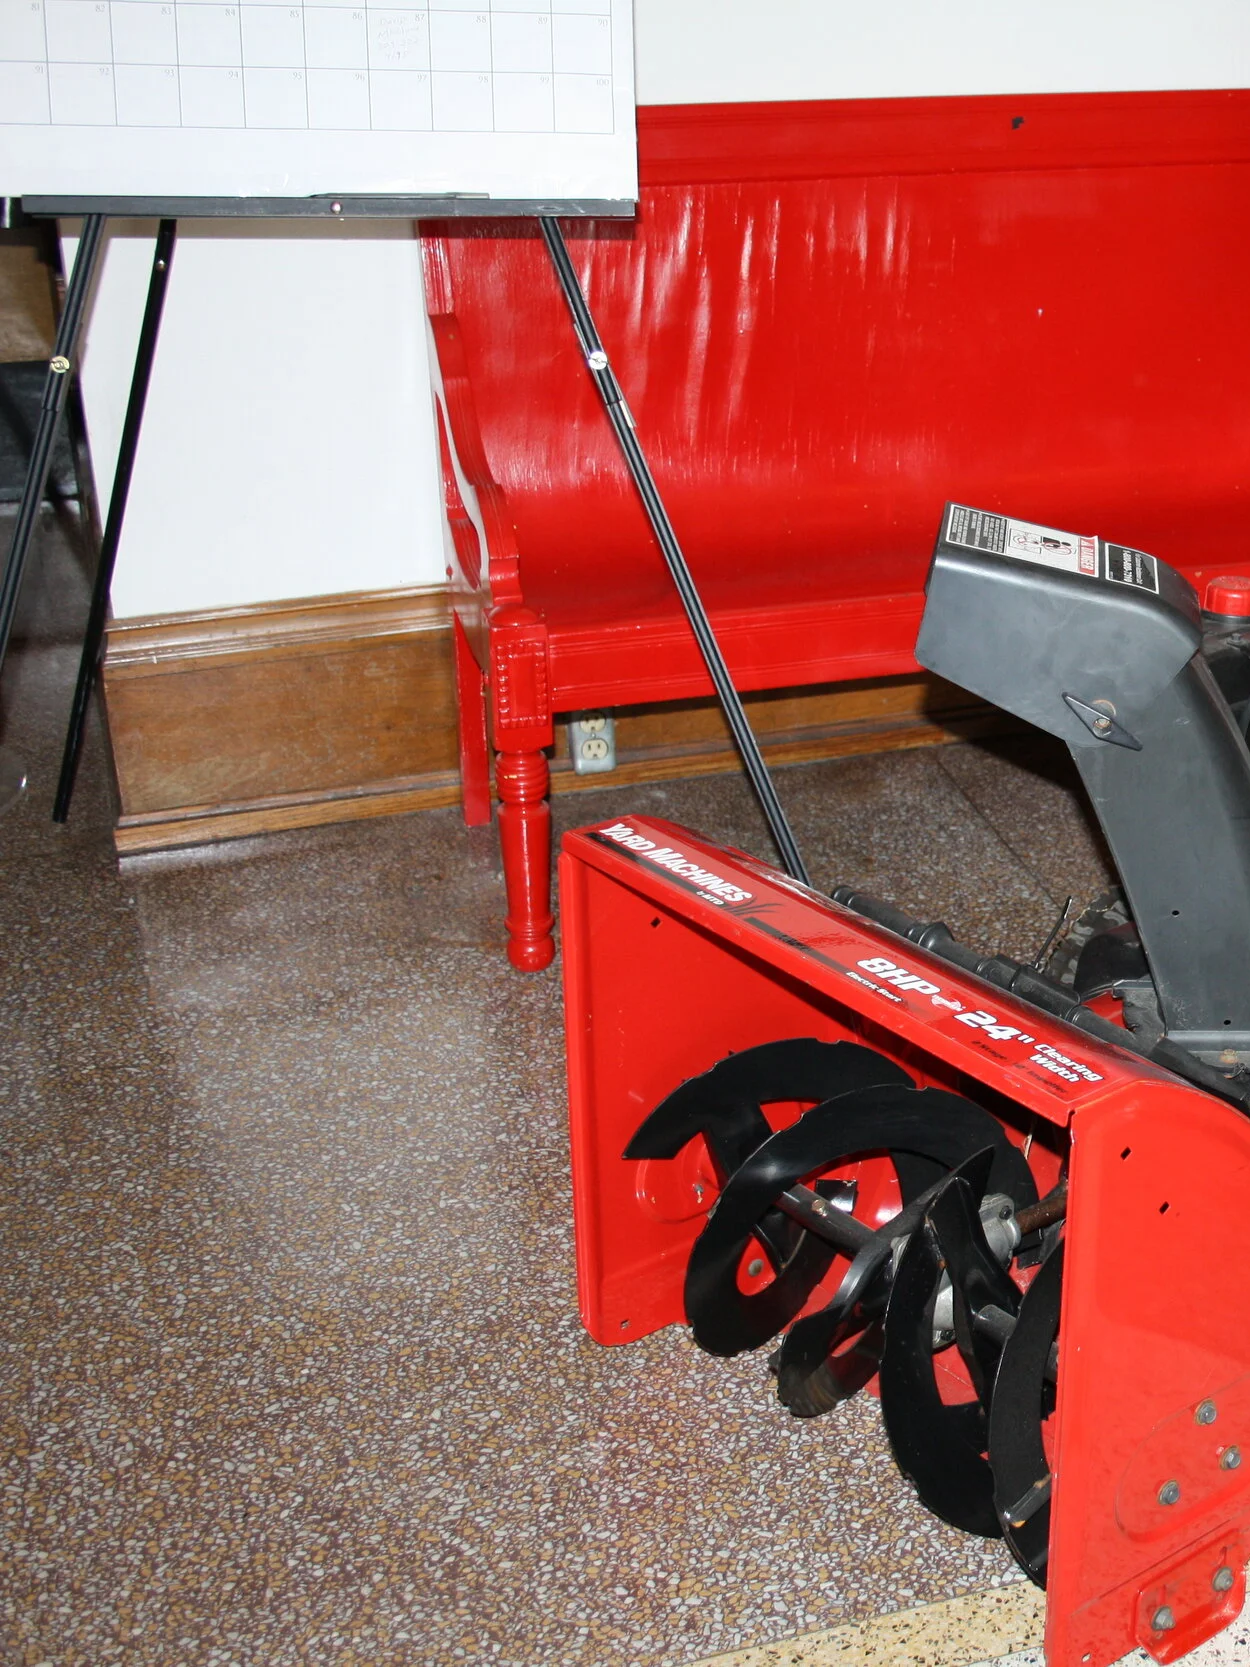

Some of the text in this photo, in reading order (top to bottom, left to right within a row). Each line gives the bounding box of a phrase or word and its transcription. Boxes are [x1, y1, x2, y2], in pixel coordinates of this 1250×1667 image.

[599, 823, 753, 903] YARD MACHINES
[703, 893, 725, 906] MTD
[845, 971, 904, 1003] Electric Start
[856, 957, 942, 995] 8HP
[1028, 1053, 1080, 1082] Width
[1033, 1043, 1104, 1082] Clearing
